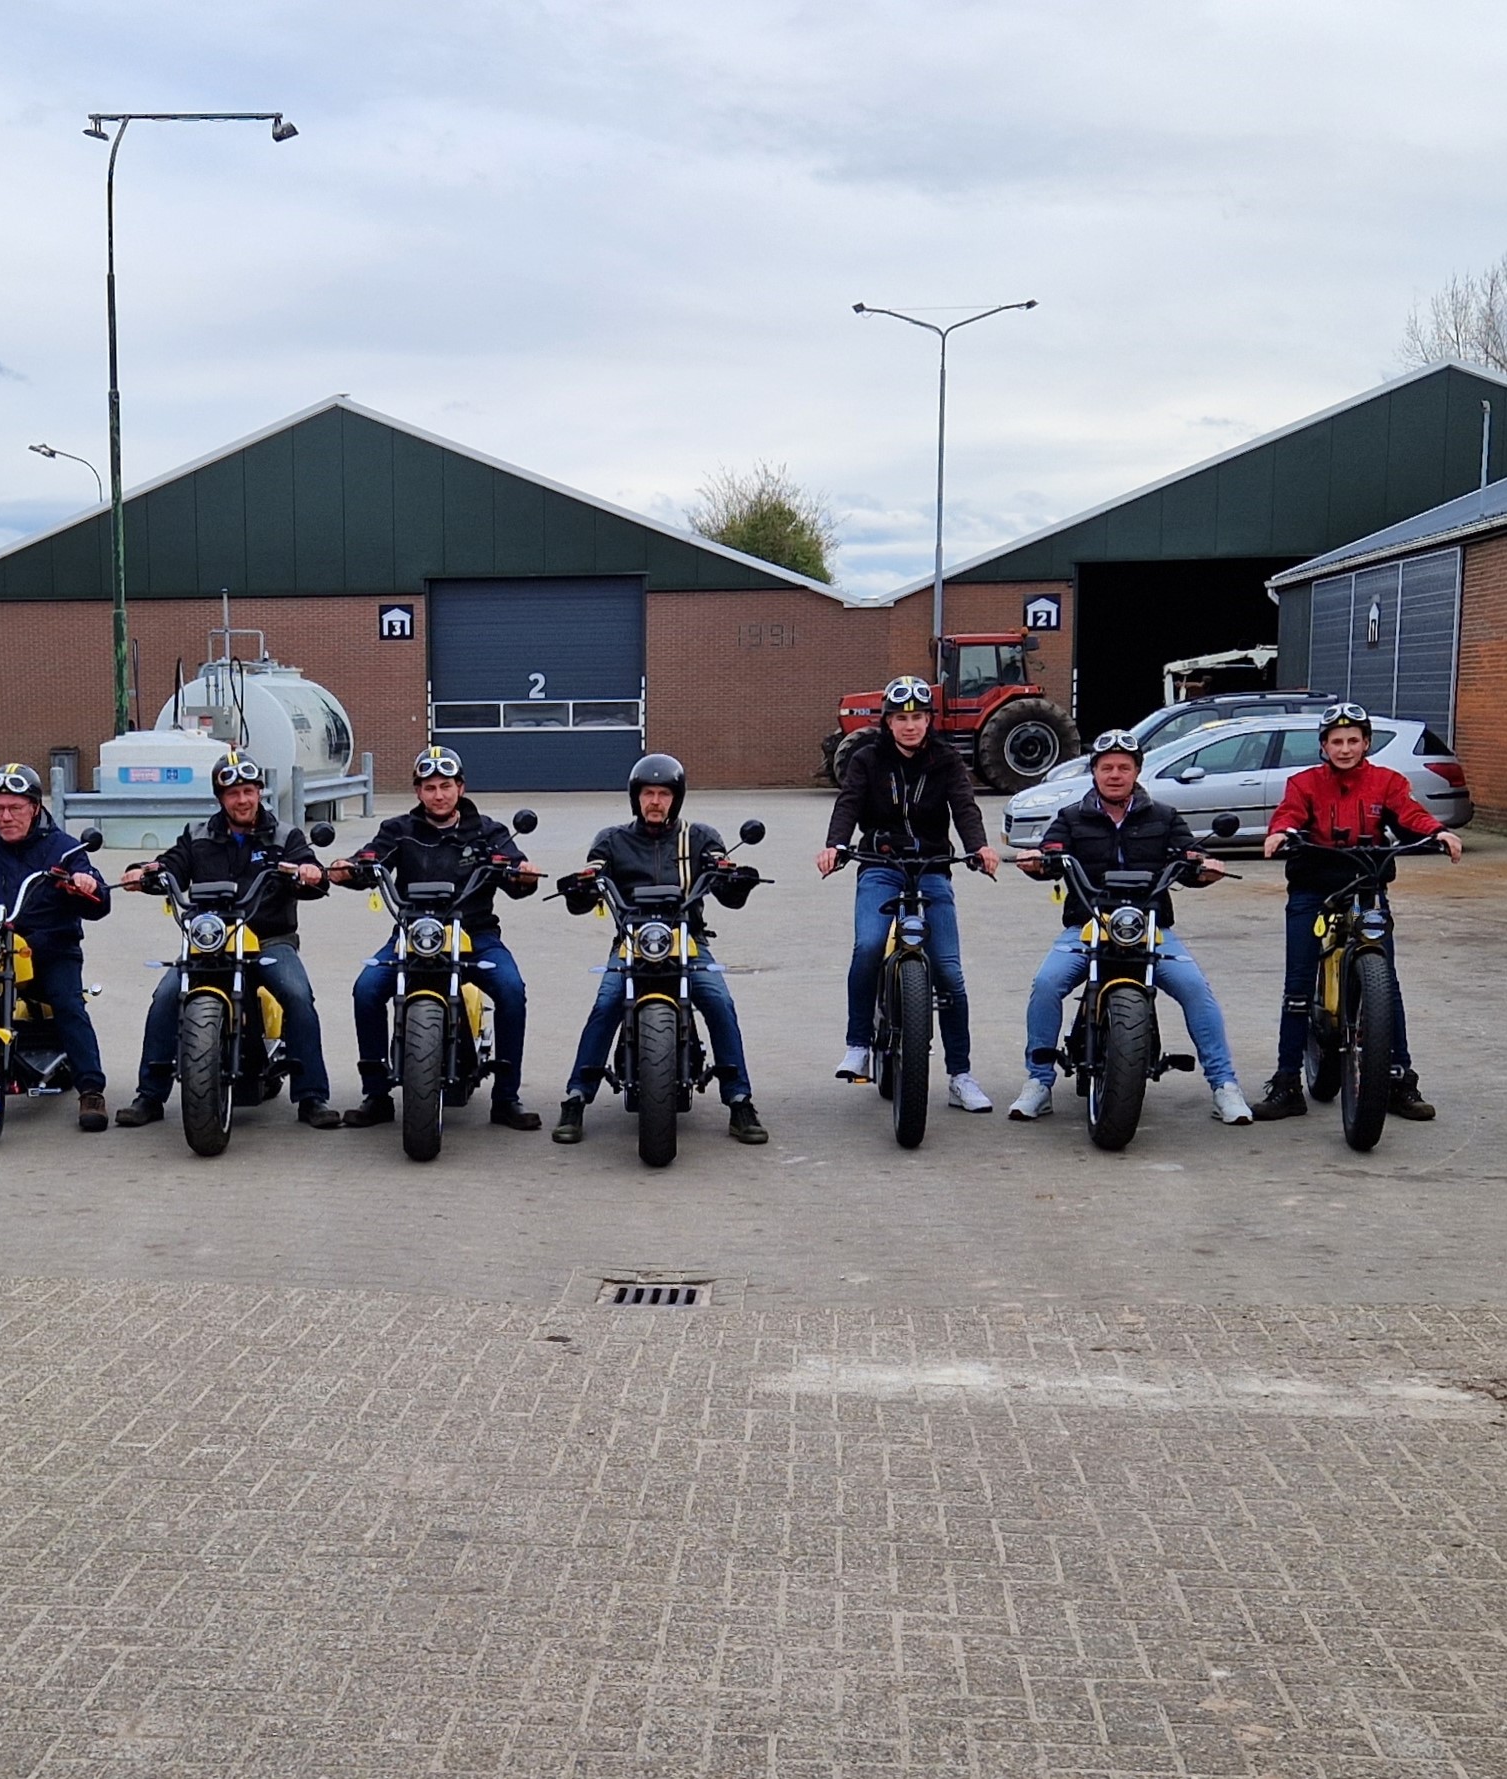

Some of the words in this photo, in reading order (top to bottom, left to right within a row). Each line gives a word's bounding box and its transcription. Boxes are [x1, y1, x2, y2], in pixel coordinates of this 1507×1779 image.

[1036, 611, 1047, 627] 2
[392, 621, 401, 636] 3
[738, 624, 795, 648] 1991
[528, 672, 546, 699] 2
[222, 707, 230, 715] 2
